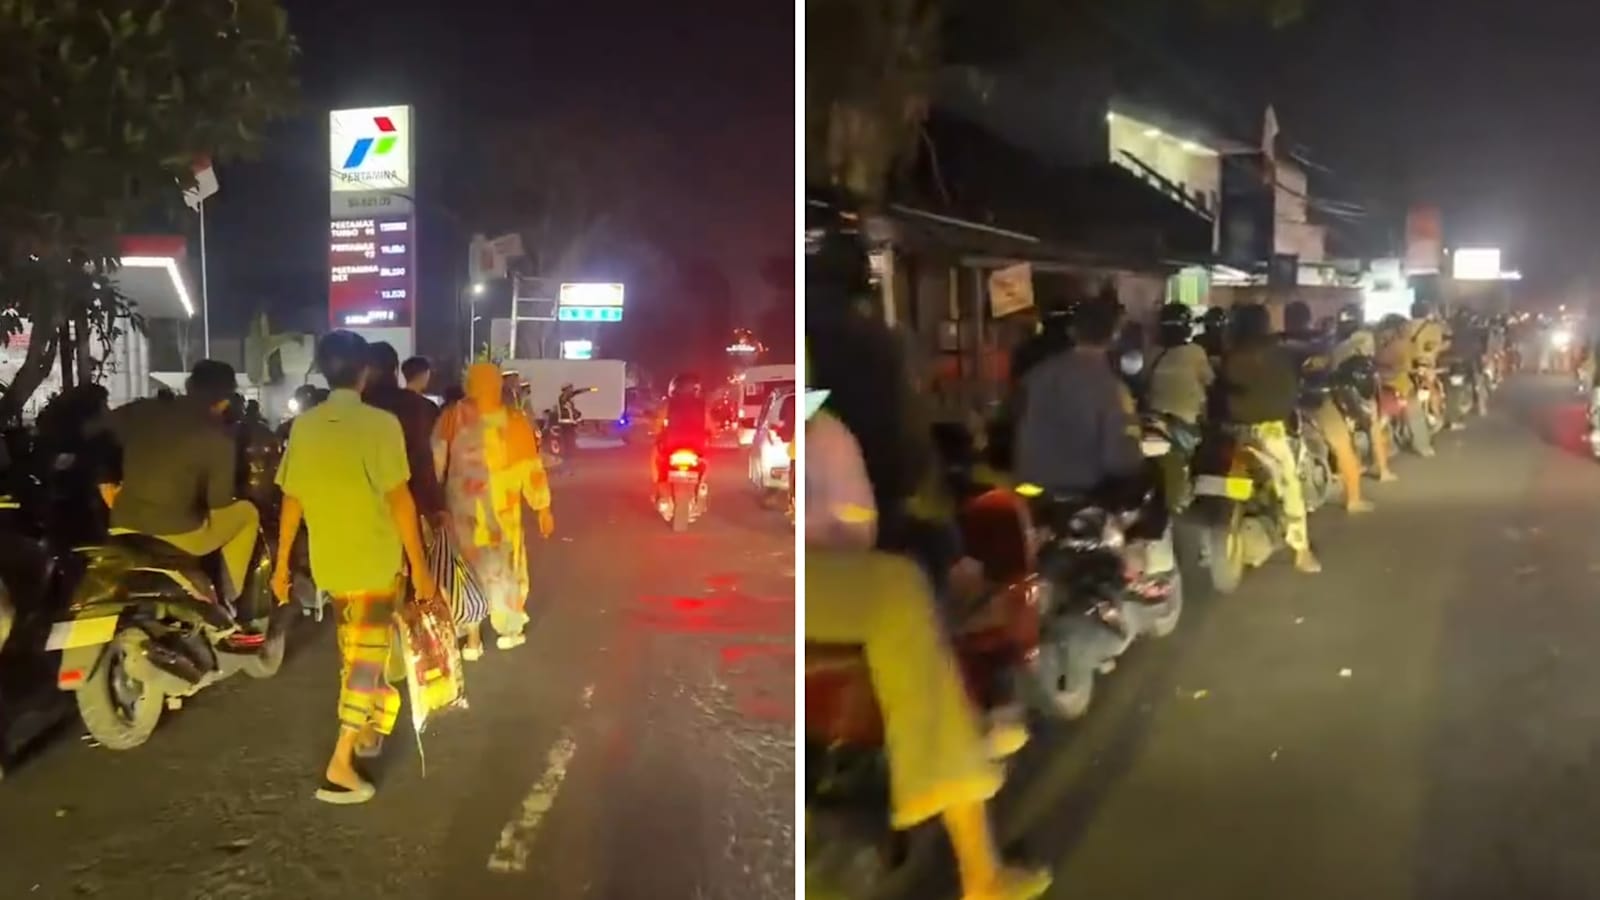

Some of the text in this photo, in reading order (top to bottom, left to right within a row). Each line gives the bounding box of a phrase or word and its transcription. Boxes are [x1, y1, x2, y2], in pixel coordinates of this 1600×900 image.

[340, 170, 397, 183] PERTAMINA
[330, 219, 375, 230] PERTAMAX
[330, 228, 360, 237] TURBO
[331, 265, 379, 275] PERTAMINA
[331, 274, 349, 283] DEX
